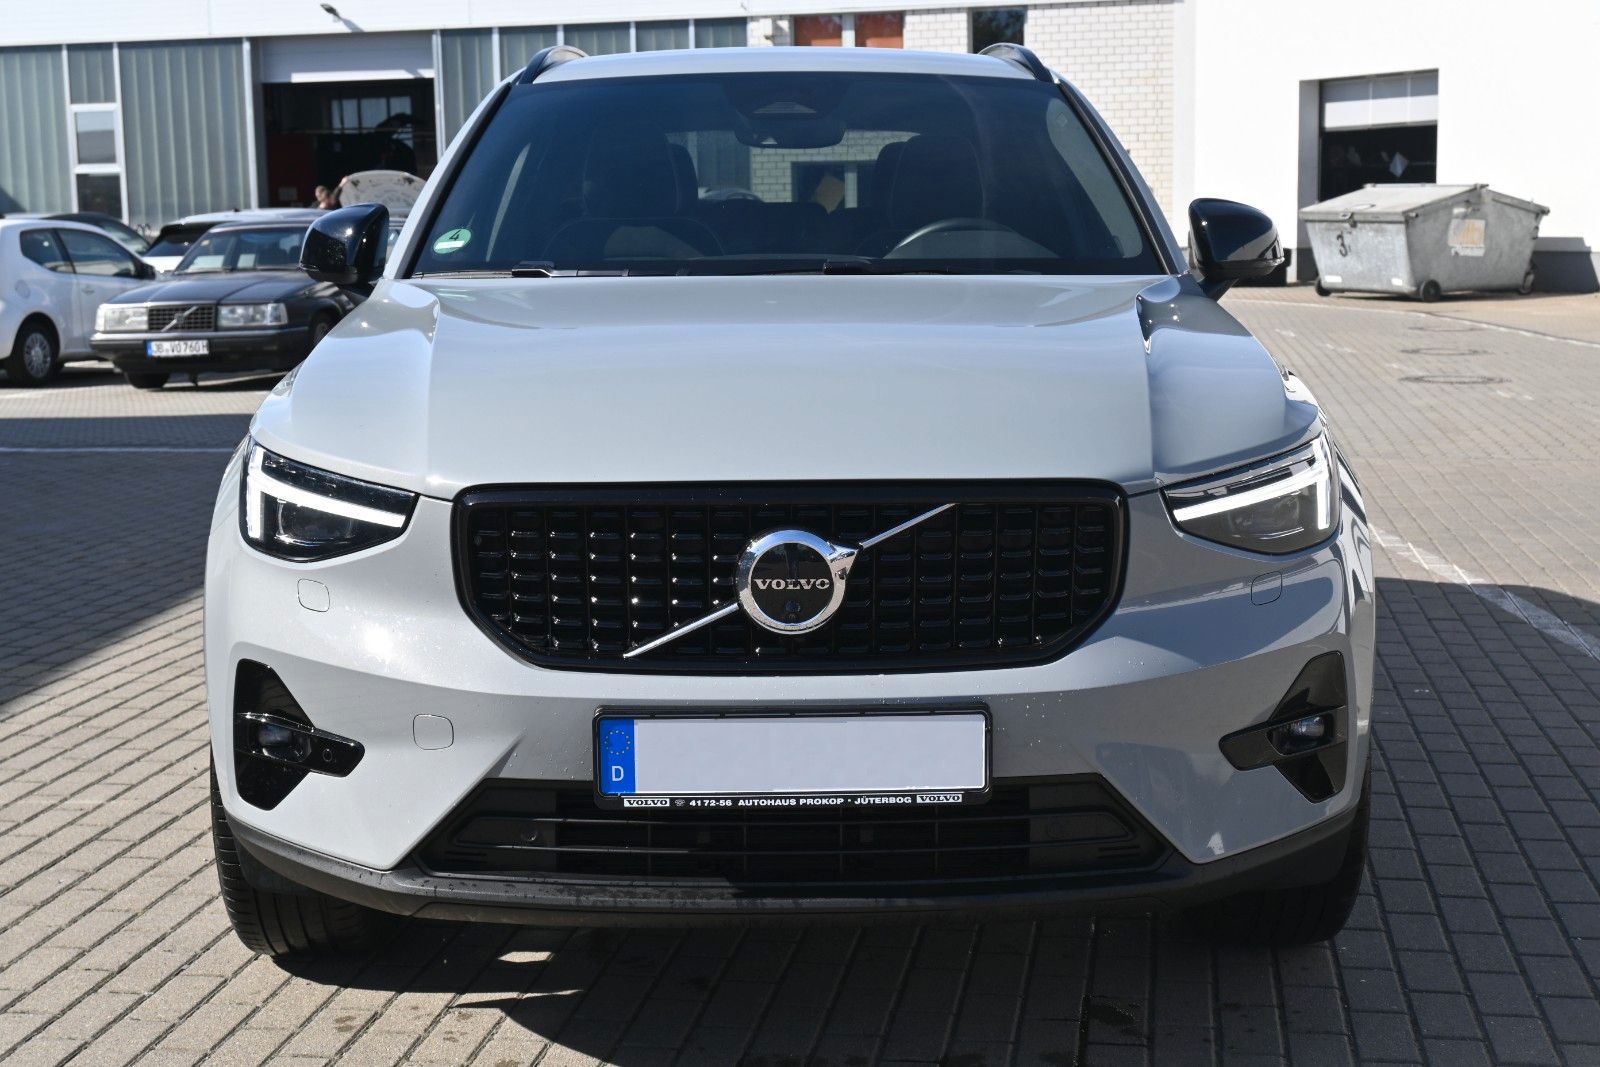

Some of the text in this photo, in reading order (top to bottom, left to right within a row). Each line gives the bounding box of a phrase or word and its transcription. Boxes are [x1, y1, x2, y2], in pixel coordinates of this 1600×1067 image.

[449, 229, 461, 241] 4
[753, 578, 831, 590] VOLVO
[611, 765, 624, 782] D
[626, 799, 668, 807] VOLVO
[738, 798, 797, 807] AUTOHAUS
[799, 797, 844, 806] PROKOP
[854, 795, 912, 805] JÜTERBOG
[919, 794, 961, 803] VOLVO
